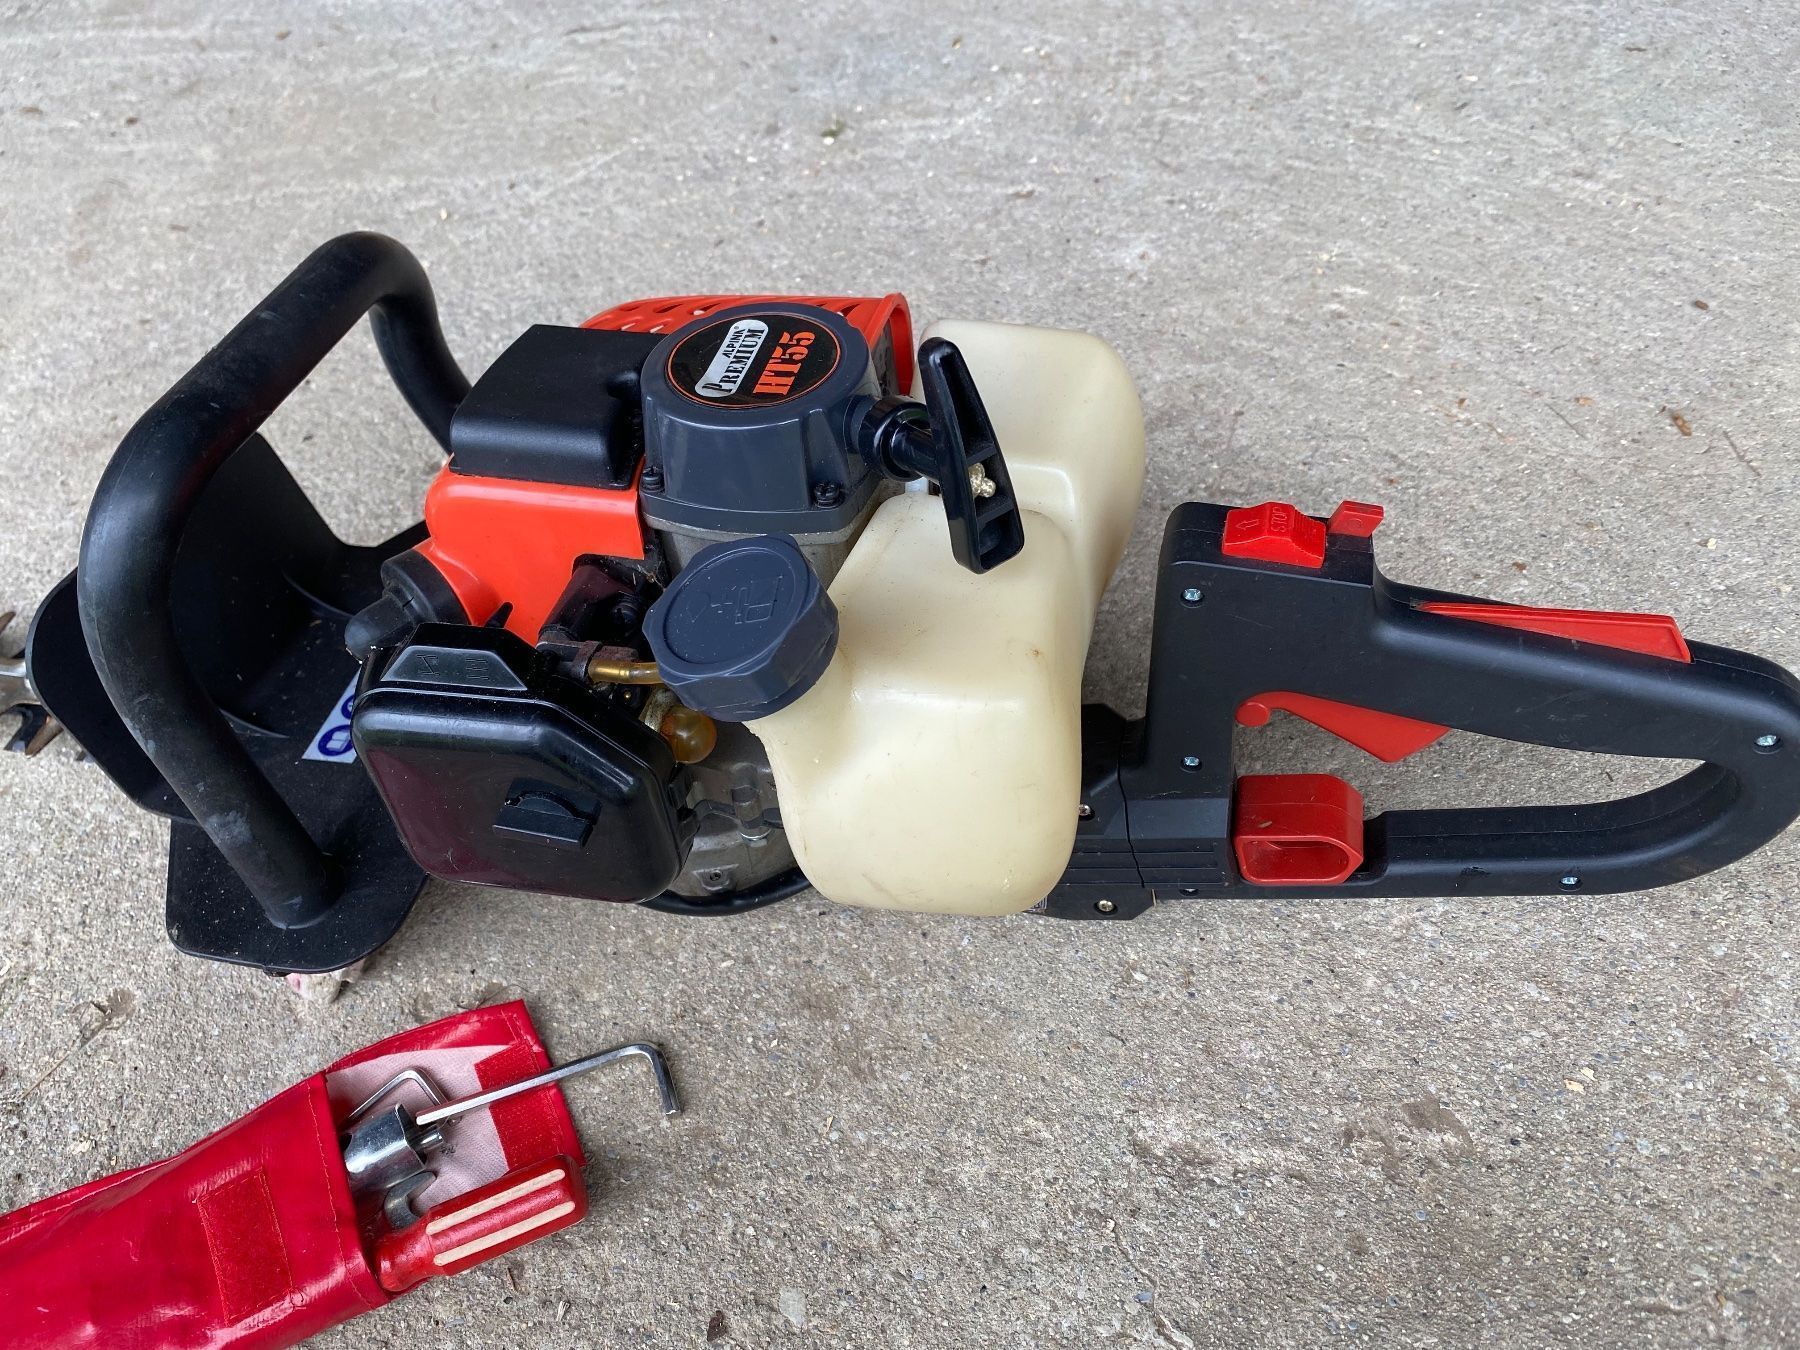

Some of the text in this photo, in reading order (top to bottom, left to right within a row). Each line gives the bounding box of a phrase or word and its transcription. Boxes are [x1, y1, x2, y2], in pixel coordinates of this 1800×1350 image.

[702, 328, 765, 394] PREMIUM
[722, 328, 746, 359] ALPINA
[752, 331, 816, 396] HT55
[1270, 506, 1288, 533] STOP
